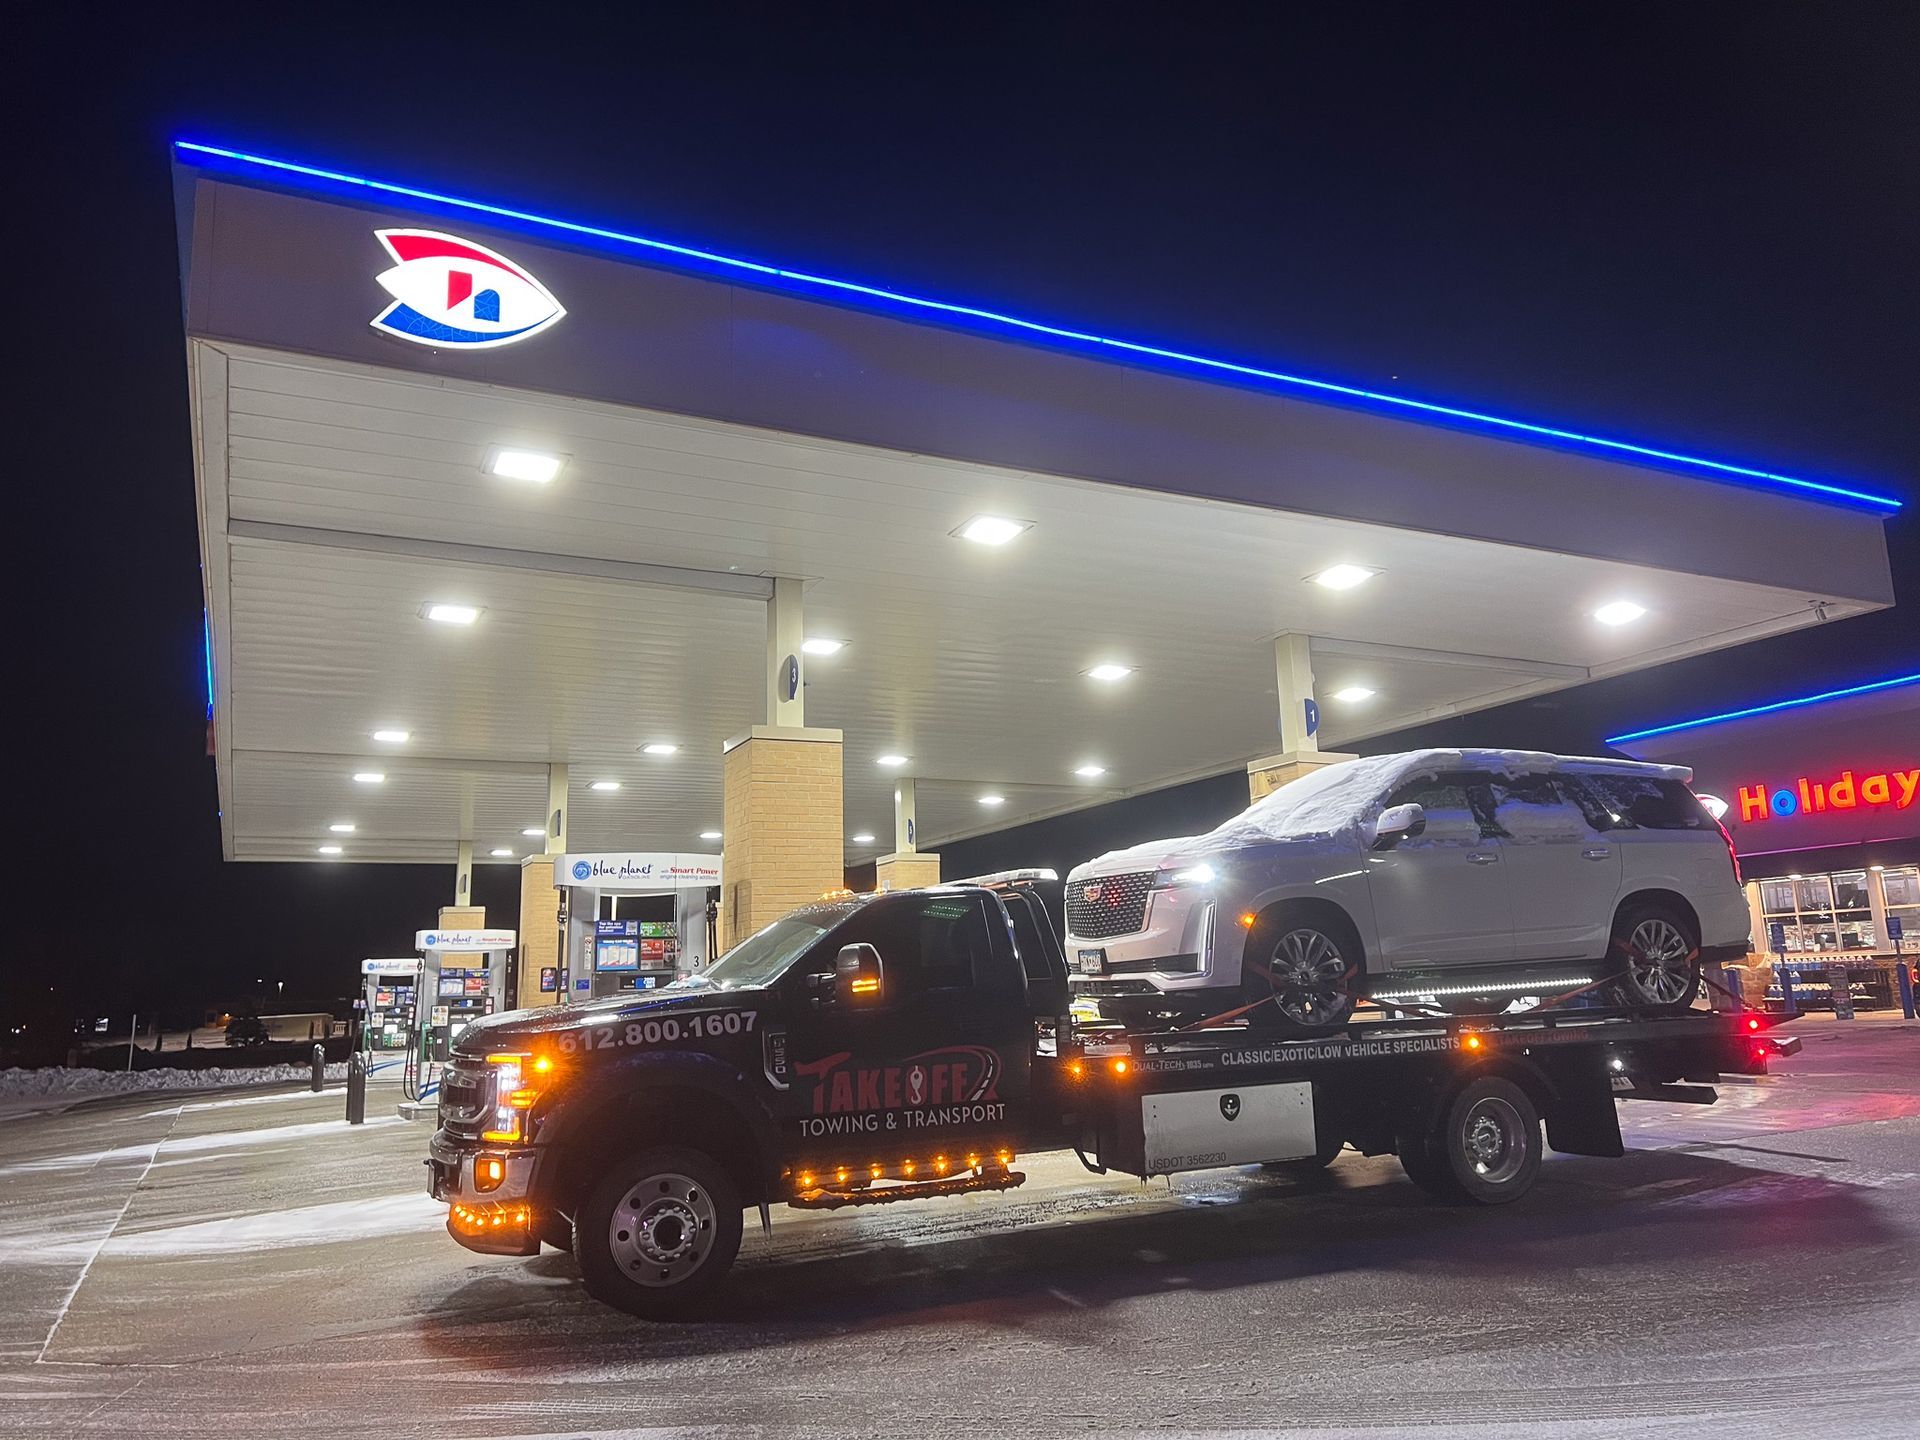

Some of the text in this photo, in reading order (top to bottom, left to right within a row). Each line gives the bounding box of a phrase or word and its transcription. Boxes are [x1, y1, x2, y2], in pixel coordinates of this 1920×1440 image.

[791, 667, 797, 683] 3
[1738, 770, 1920, 822] Holiday
[593, 859, 653, 879] blue planet
[670, 866, 694, 874] Smart
[696, 867, 719, 875] Power
[693, 955, 700, 967] 3
[557, 1011, 758, 1053] 612.800.1607
[1221, 1036, 1461, 1066] CLASSIC/EXOTIC/LOW VEHICLE SPECIALISTS
[794, 1050, 970, 1114] TAKEOFF
[800, 1103, 1006, 1137] TOWING & TRANSPORT
[1148, 1152, 1227, 1170] USDOT 3562230
